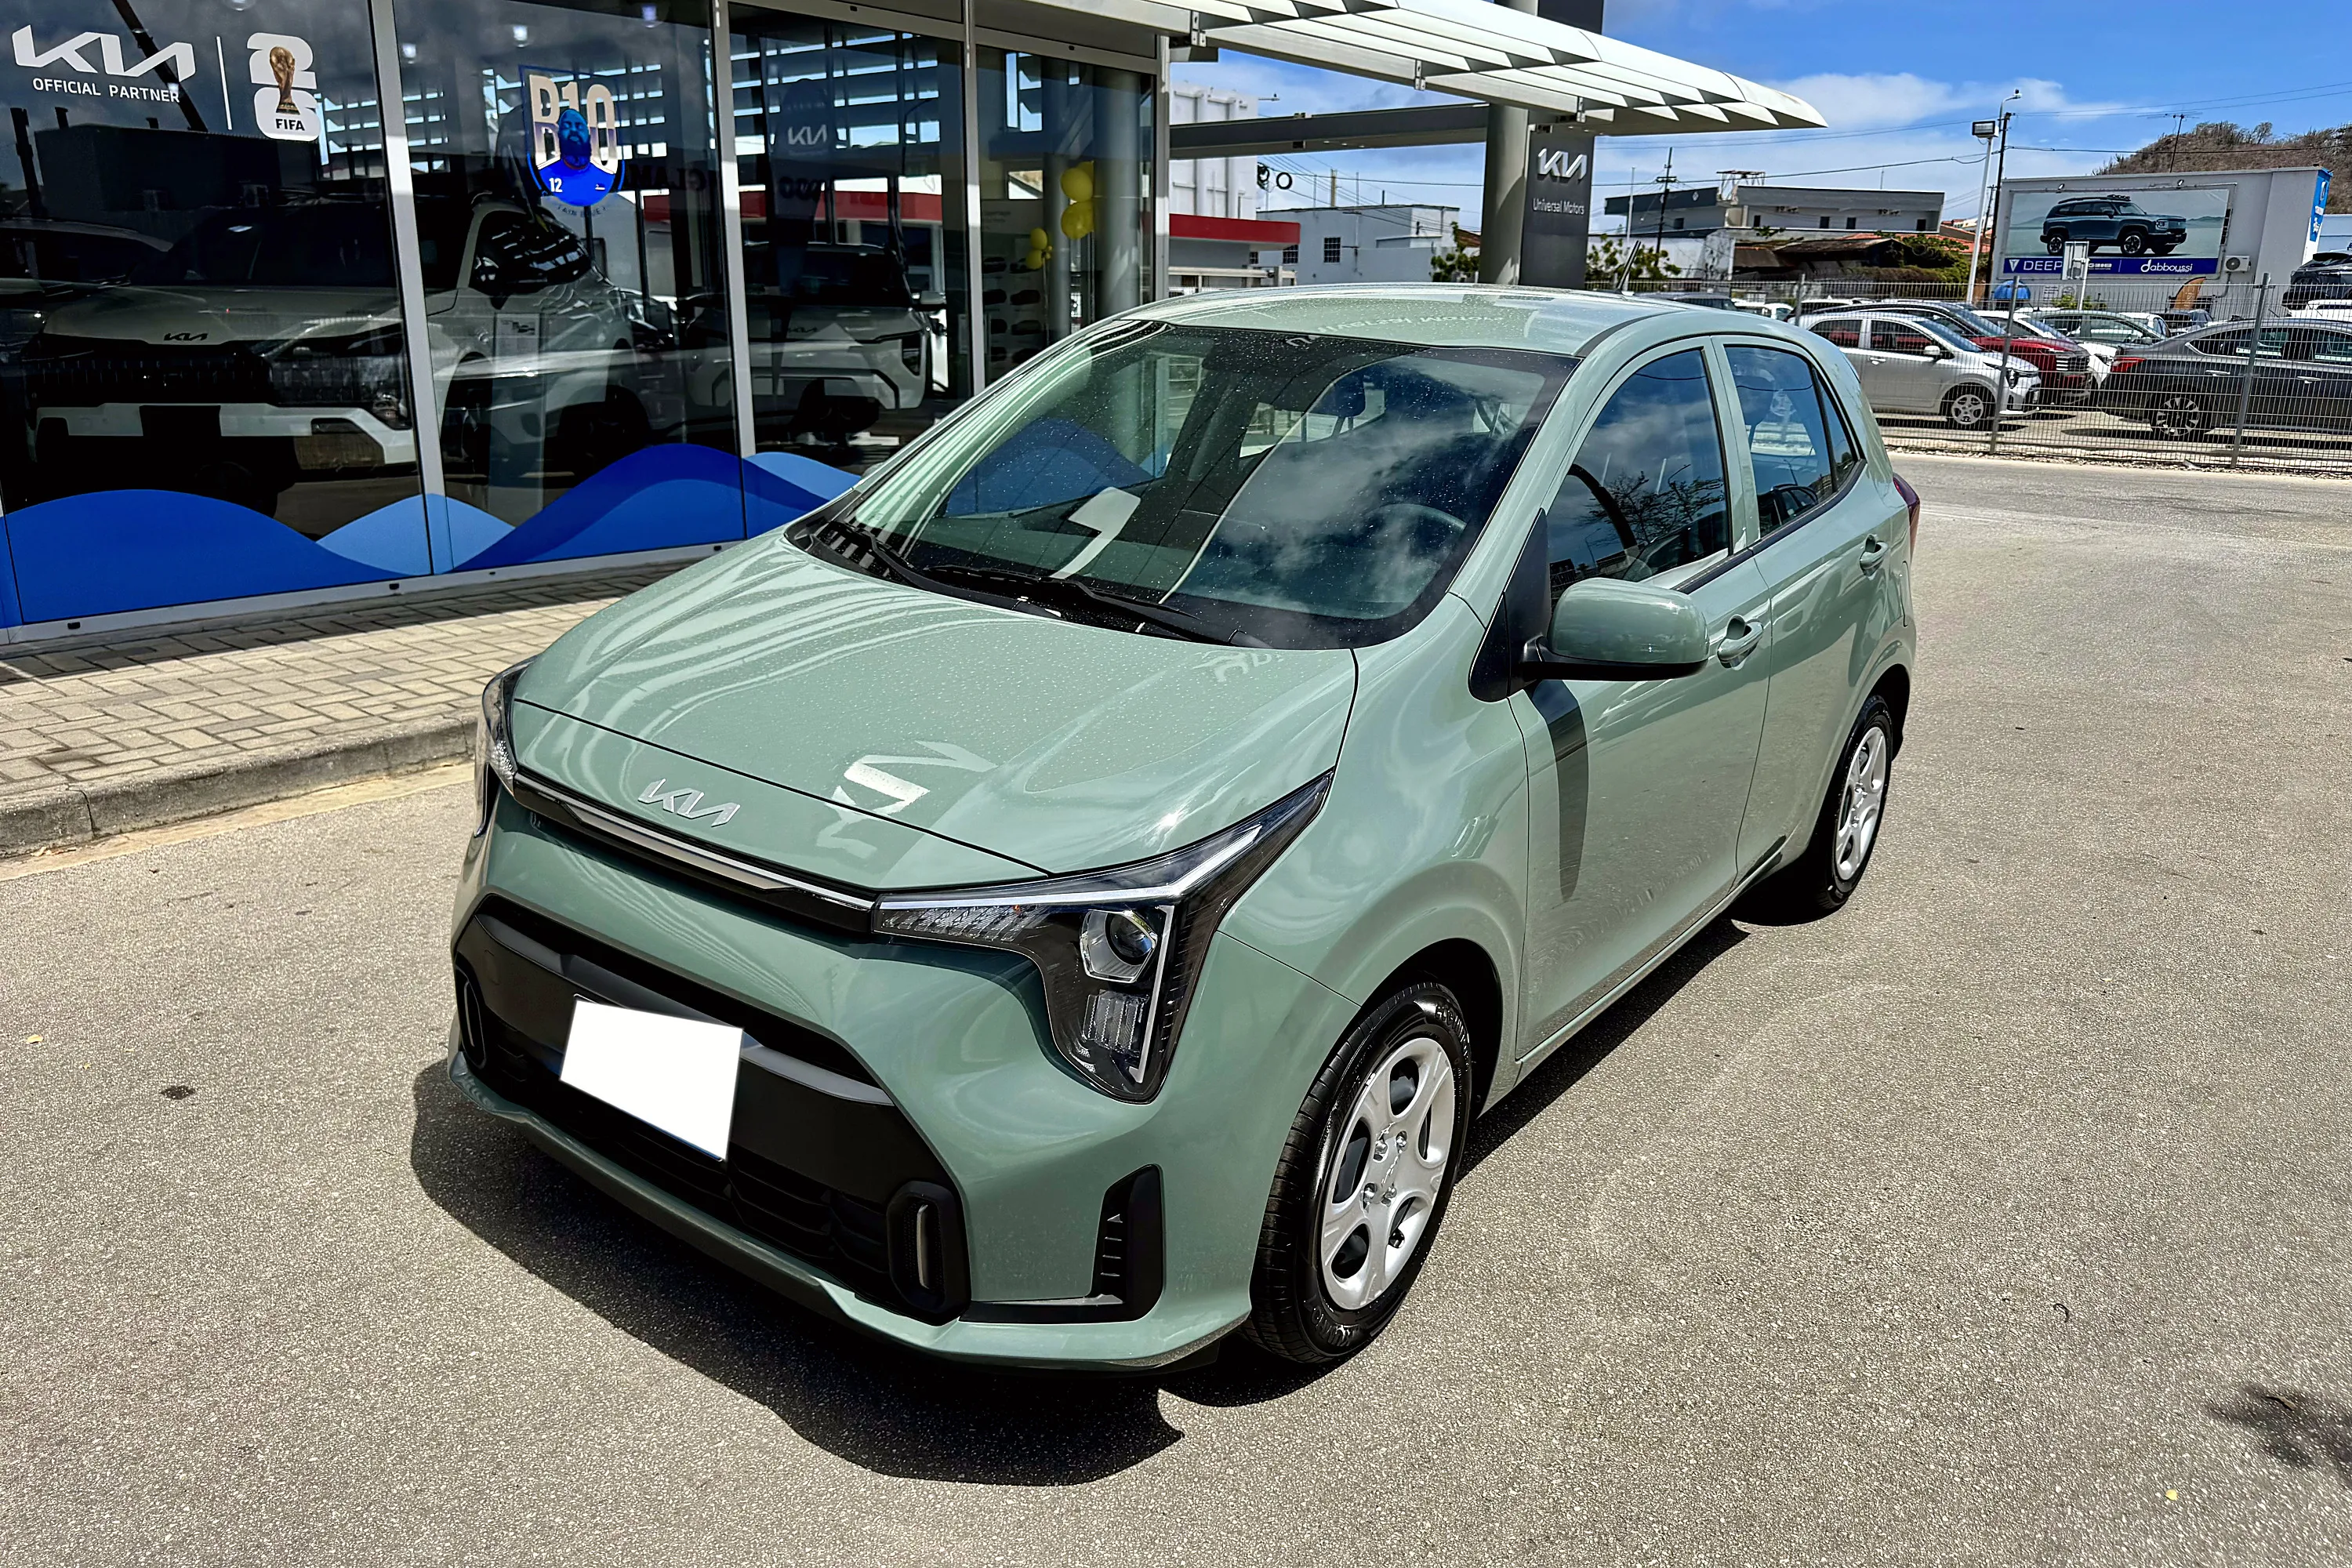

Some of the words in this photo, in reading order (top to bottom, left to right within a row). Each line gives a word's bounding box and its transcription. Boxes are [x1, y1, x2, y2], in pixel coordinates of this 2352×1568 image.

[12, 25, 195, 82] KIA
[33, 78, 101, 96] OFFICIAL
[110, 85, 180, 103] PARTNER
[276, 118, 305, 131] FIFA
[788, 124, 828, 145] KIA
[1538, 148, 1587, 180] KIA
[549, 178, 562, 192] 12
[1533, 198, 1562, 212] Universal
[1563, 201, 1584, 215] Motors
[2140, 259, 2193, 272] dabboussi
[164, 332, 208, 342] KIA
[637, 779, 741, 827] KIA
